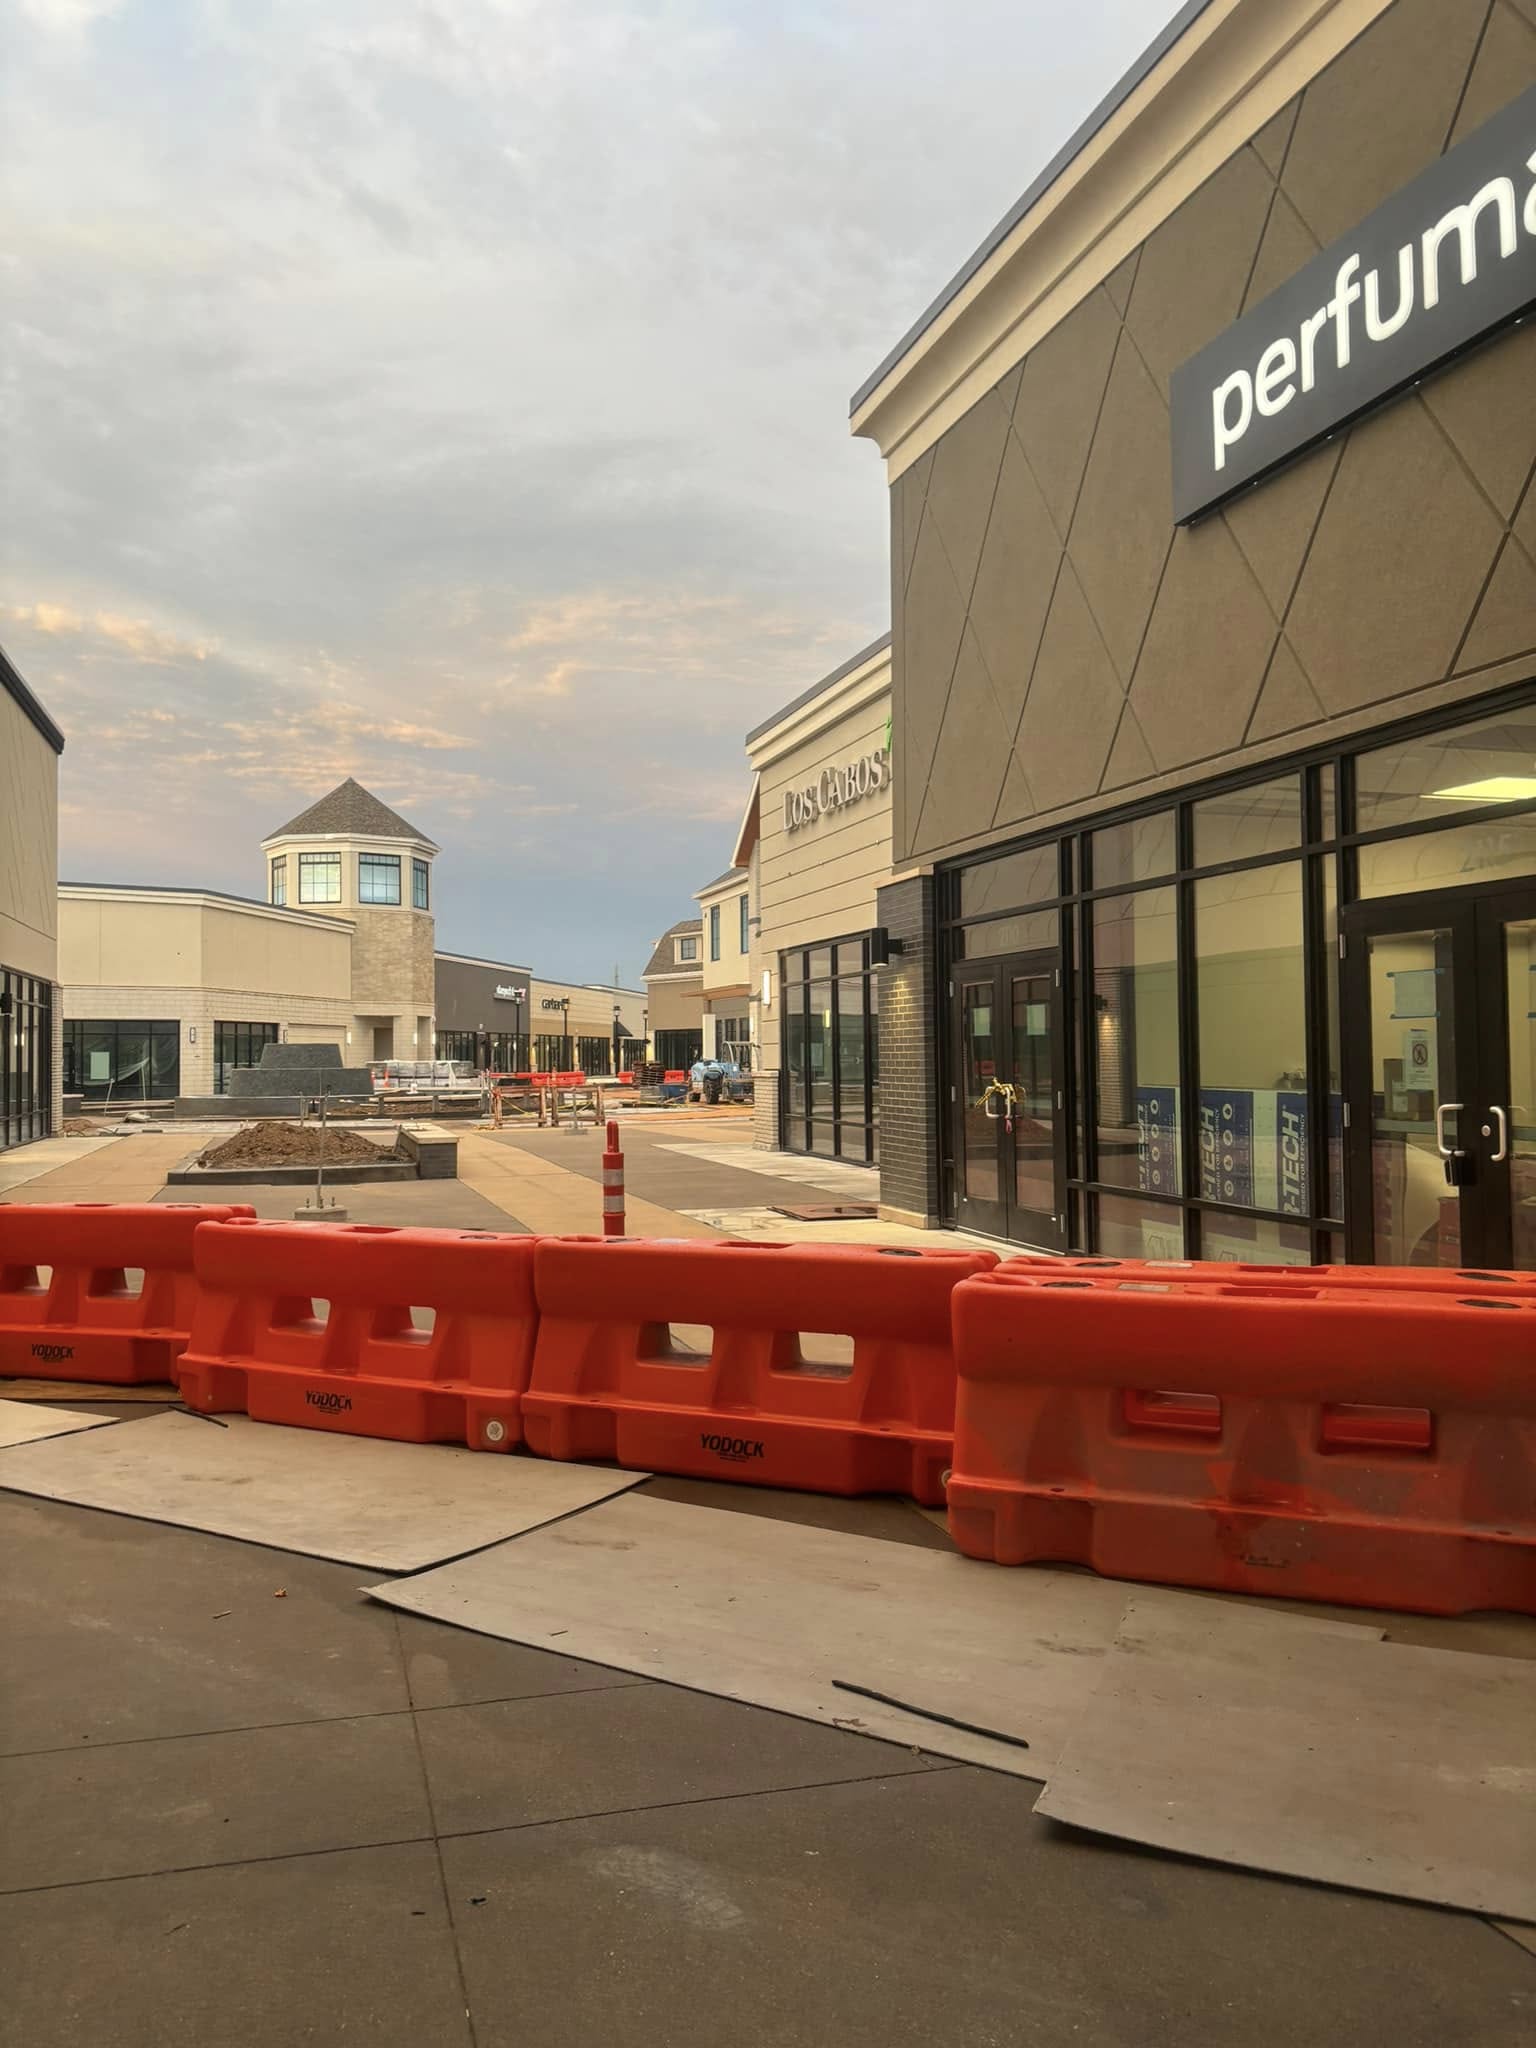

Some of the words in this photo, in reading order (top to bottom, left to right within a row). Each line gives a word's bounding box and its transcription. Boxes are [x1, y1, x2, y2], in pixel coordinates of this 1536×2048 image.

[783, 787, 819, 833] LOS
[817, 748, 890, 814] CABOS
[31, 1343, 75, 1359] YODOCK
[304, 1389, 353, 1411] YODOCK
[700, 1433, 765, 1458] YODOCK
